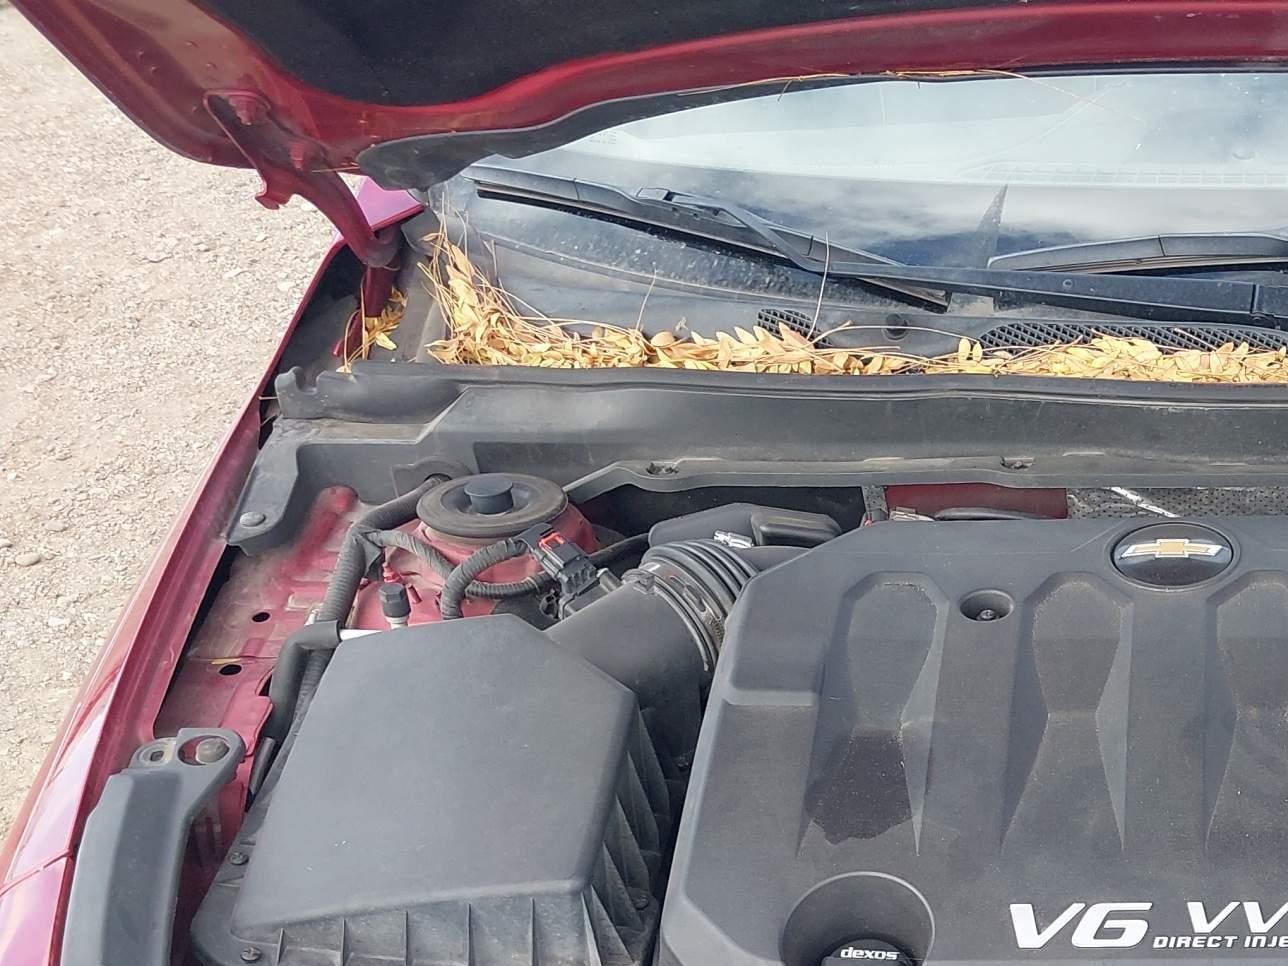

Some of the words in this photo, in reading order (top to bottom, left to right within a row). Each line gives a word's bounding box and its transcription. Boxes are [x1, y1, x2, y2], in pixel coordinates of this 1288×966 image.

[1008, 901, 1153, 949] V6
[1152, 934, 1238, 949] DIRECT
[840, 946, 900, 960] dexos
